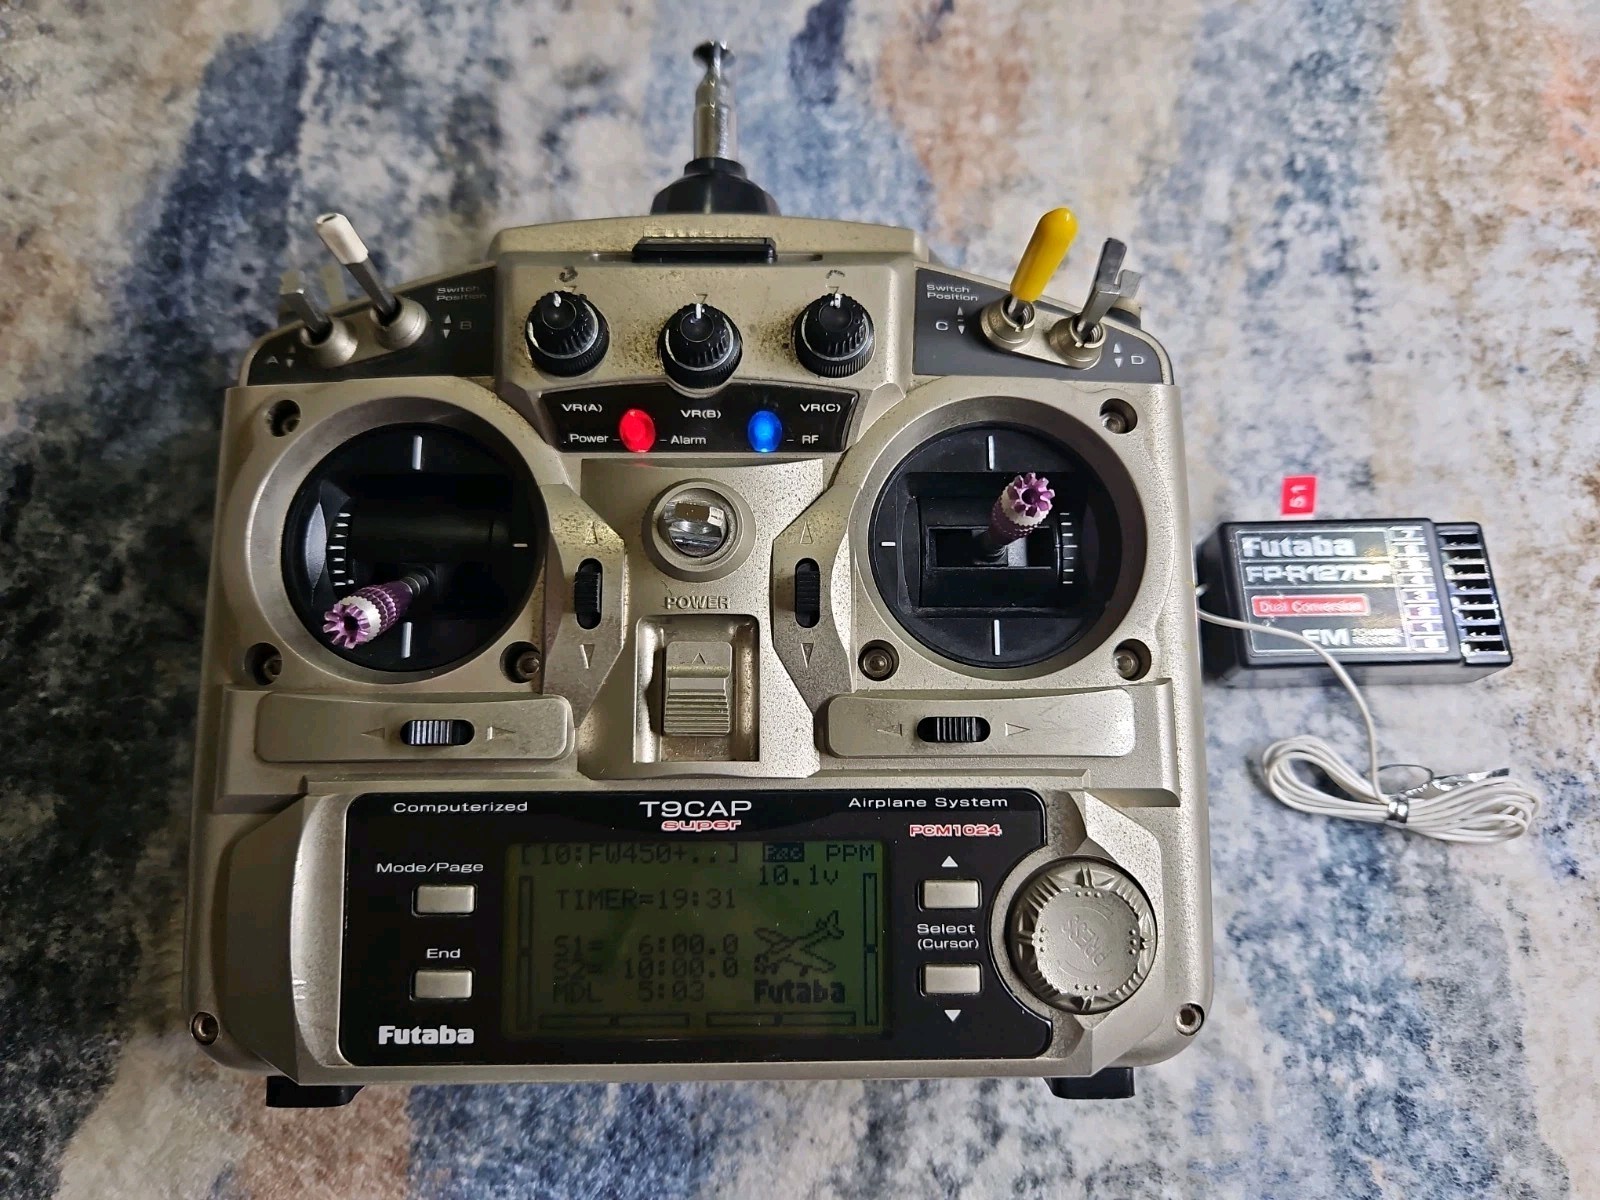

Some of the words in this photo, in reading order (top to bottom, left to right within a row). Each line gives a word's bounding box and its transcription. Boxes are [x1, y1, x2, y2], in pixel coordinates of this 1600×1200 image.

[437, 286, 480, 294] Switch
[926, 284, 970, 293] Switch
[436, 293, 488, 302] Position
[927, 292, 979, 301] Position
[935, 321, 949, 331] C
[1131, 355, 1144, 365] D
[562, 403, 603, 413] VR(A)
[800, 403, 841, 413] VR(C)
[680, 409, 722, 420] VR(B)
[570, 433, 609, 444] Power
[671, 434, 707, 445] Alarm
[802, 434, 819, 445] RF
[1241, 535, 1357, 558] Futaba
[664, 595, 731, 610] POWER
[1259, 601, 1288, 614] Dual
[393, 801, 528, 814] Computerized
[848, 797, 927, 809] Airplane
[935, 797, 1008, 809] System
[639, 800, 752, 818] T9CAP
[661, 819, 742, 832] super
[909, 824, 1002, 837] PCM1024
[826, 844, 875, 862] PPM
[376, 862, 484, 874] Mode/Page
[759, 864, 839, 886] 10.1v
[917, 923, 976, 934] Select
[917, 938, 979, 950] (Cursor)
[426, 948, 461, 959] End
[754, 979, 845, 1003] Futaba
[378, 1024, 475, 1045] Futaba
